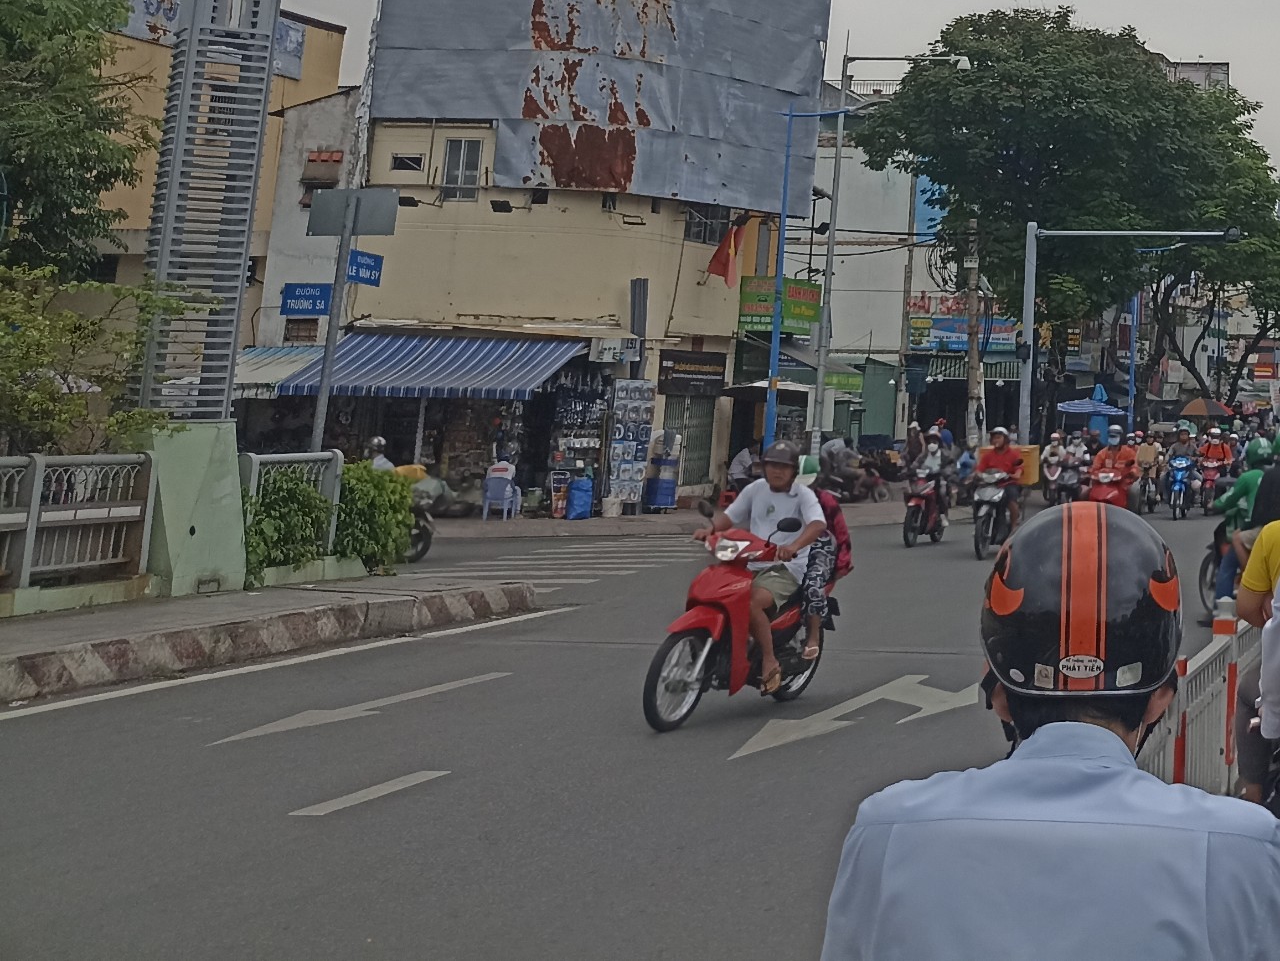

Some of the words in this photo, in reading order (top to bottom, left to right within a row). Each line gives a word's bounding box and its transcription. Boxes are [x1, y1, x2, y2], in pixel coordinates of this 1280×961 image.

[296, 287, 320, 296] ĐƯỜNG
[287, 297, 313, 309] TRƯỜNG
[316, 300, 325, 309] SA
